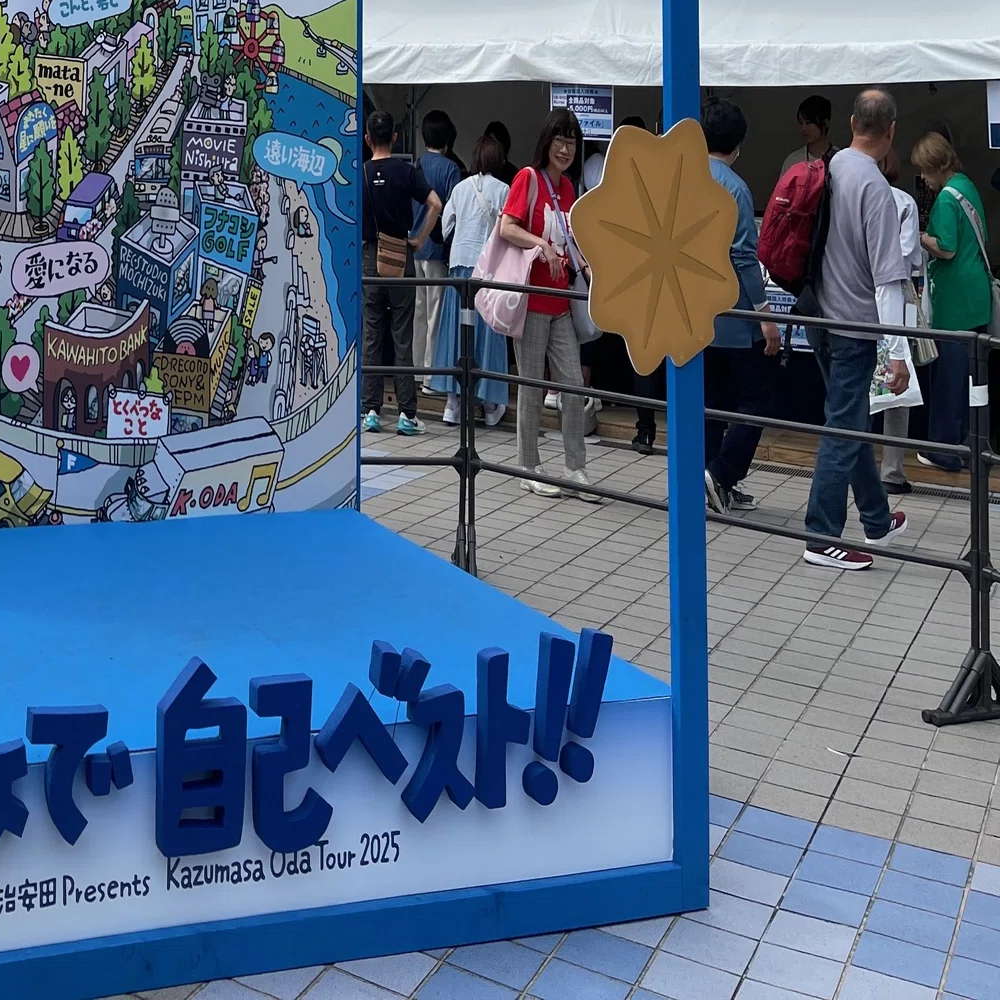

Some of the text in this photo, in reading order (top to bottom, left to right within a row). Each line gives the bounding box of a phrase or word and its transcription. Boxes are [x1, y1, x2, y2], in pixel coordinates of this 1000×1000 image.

[37, 63, 81, 82] mata
[20, 115, 57, 152] 星に願いを
[187, 136, 237, 154] MOVIE
[264, 139, 325, 177] 遠い海辺
[204, 206, 255, 239] フナコシ
[202, 230, 250, 262] GOLF
[25, 251, 98, 290] 愛になる
[118, 263, 167, 302] MOCHIZUKI
[244, 291, 258, 326] SALE
[47, 324, 148, 366] KAWAHITO BANK
[211, 331, 229, 383] MUSIC
[112, 398, 163, 421] とくべつな
[174, 389, 205, 406] FPM
[124, 418, 147, 436] こと
[67, 454, 77, 470] F
[62, 874, 150, 906] Presents
[167, 857, 265, 891] Kazumasa
[270, 850, 312, 878] Oda
[317, 839, 357, 871] Tour
[359, 830, 400, 866] 2025
